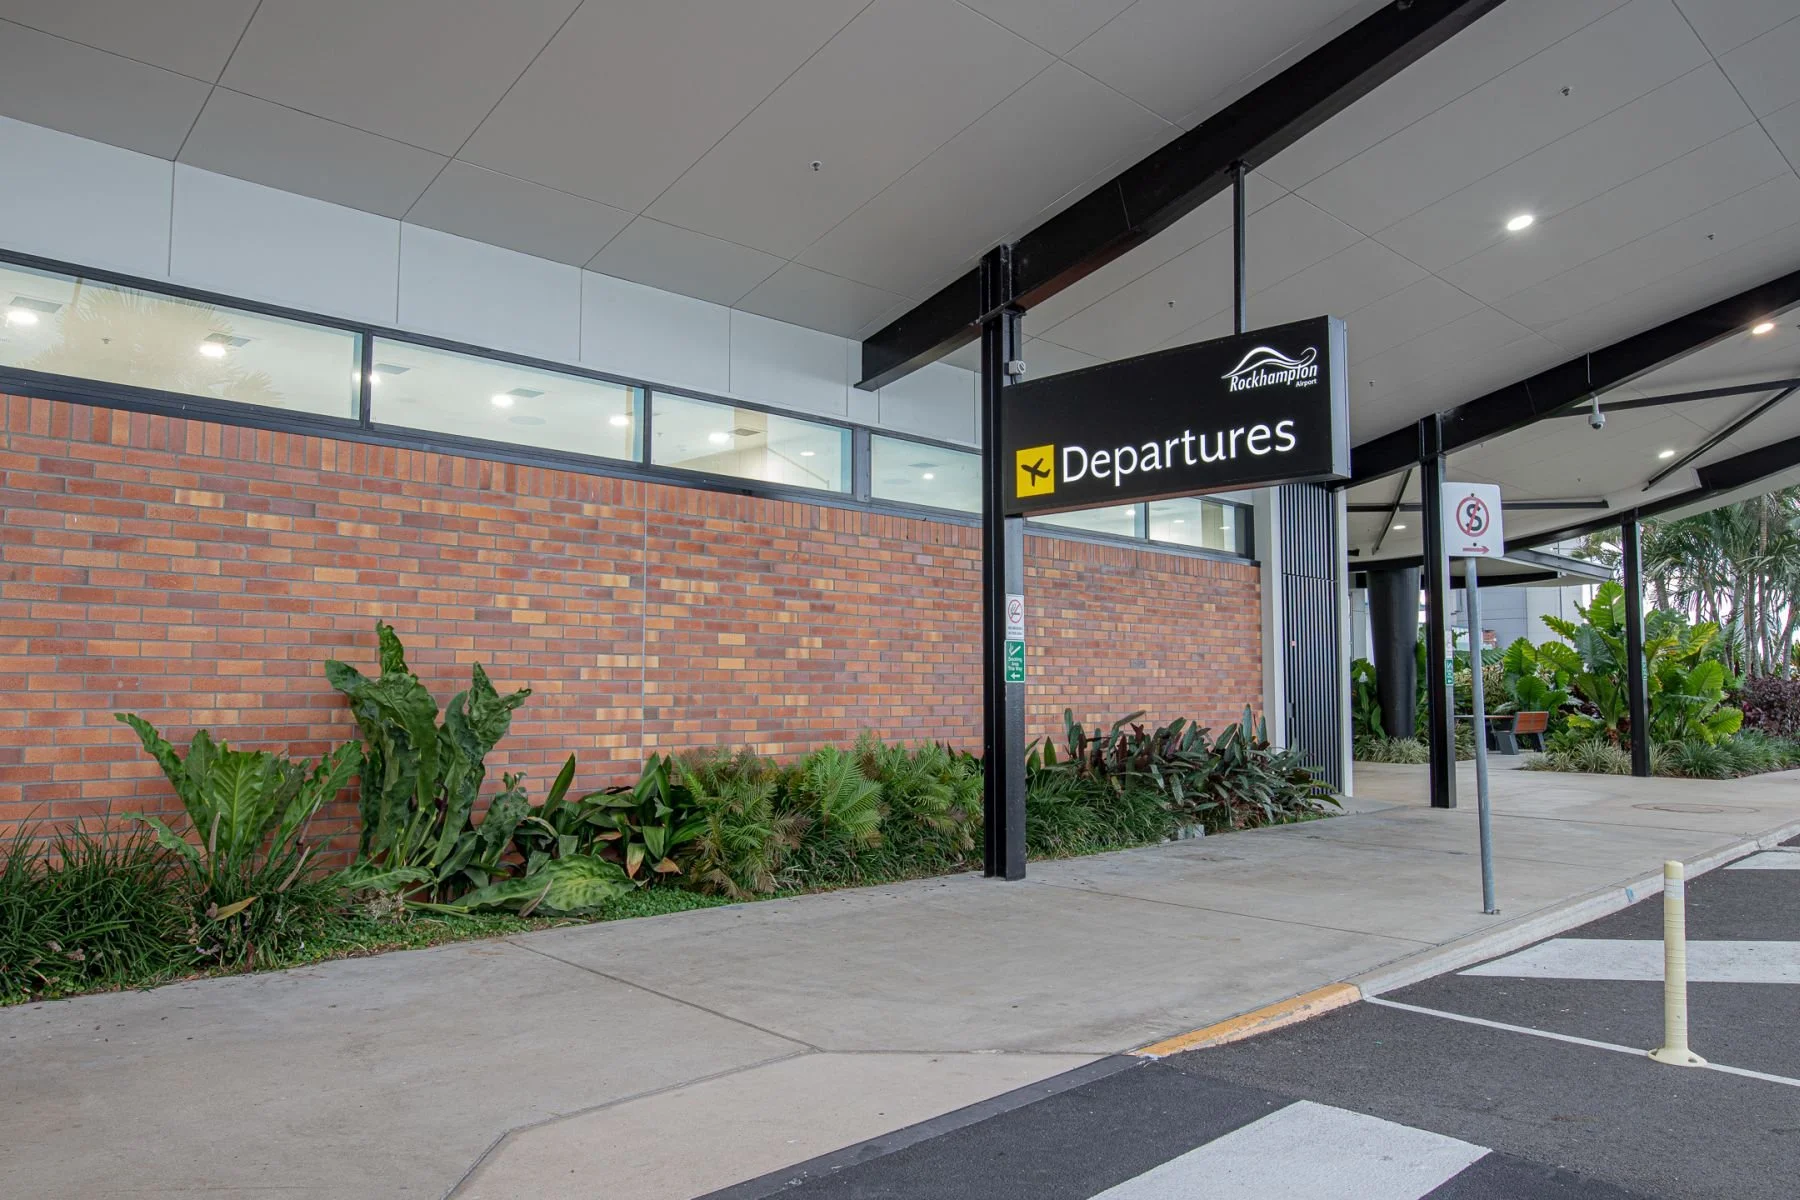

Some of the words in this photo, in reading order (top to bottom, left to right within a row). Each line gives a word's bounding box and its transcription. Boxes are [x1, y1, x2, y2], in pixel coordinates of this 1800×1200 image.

[1229, 364, 1318, 392] Rockhampton
[1295, 378, 1317, 388] Airport
[1062, 420, 1296, 486] Departures
[1465, 503, 1483, 531] S
